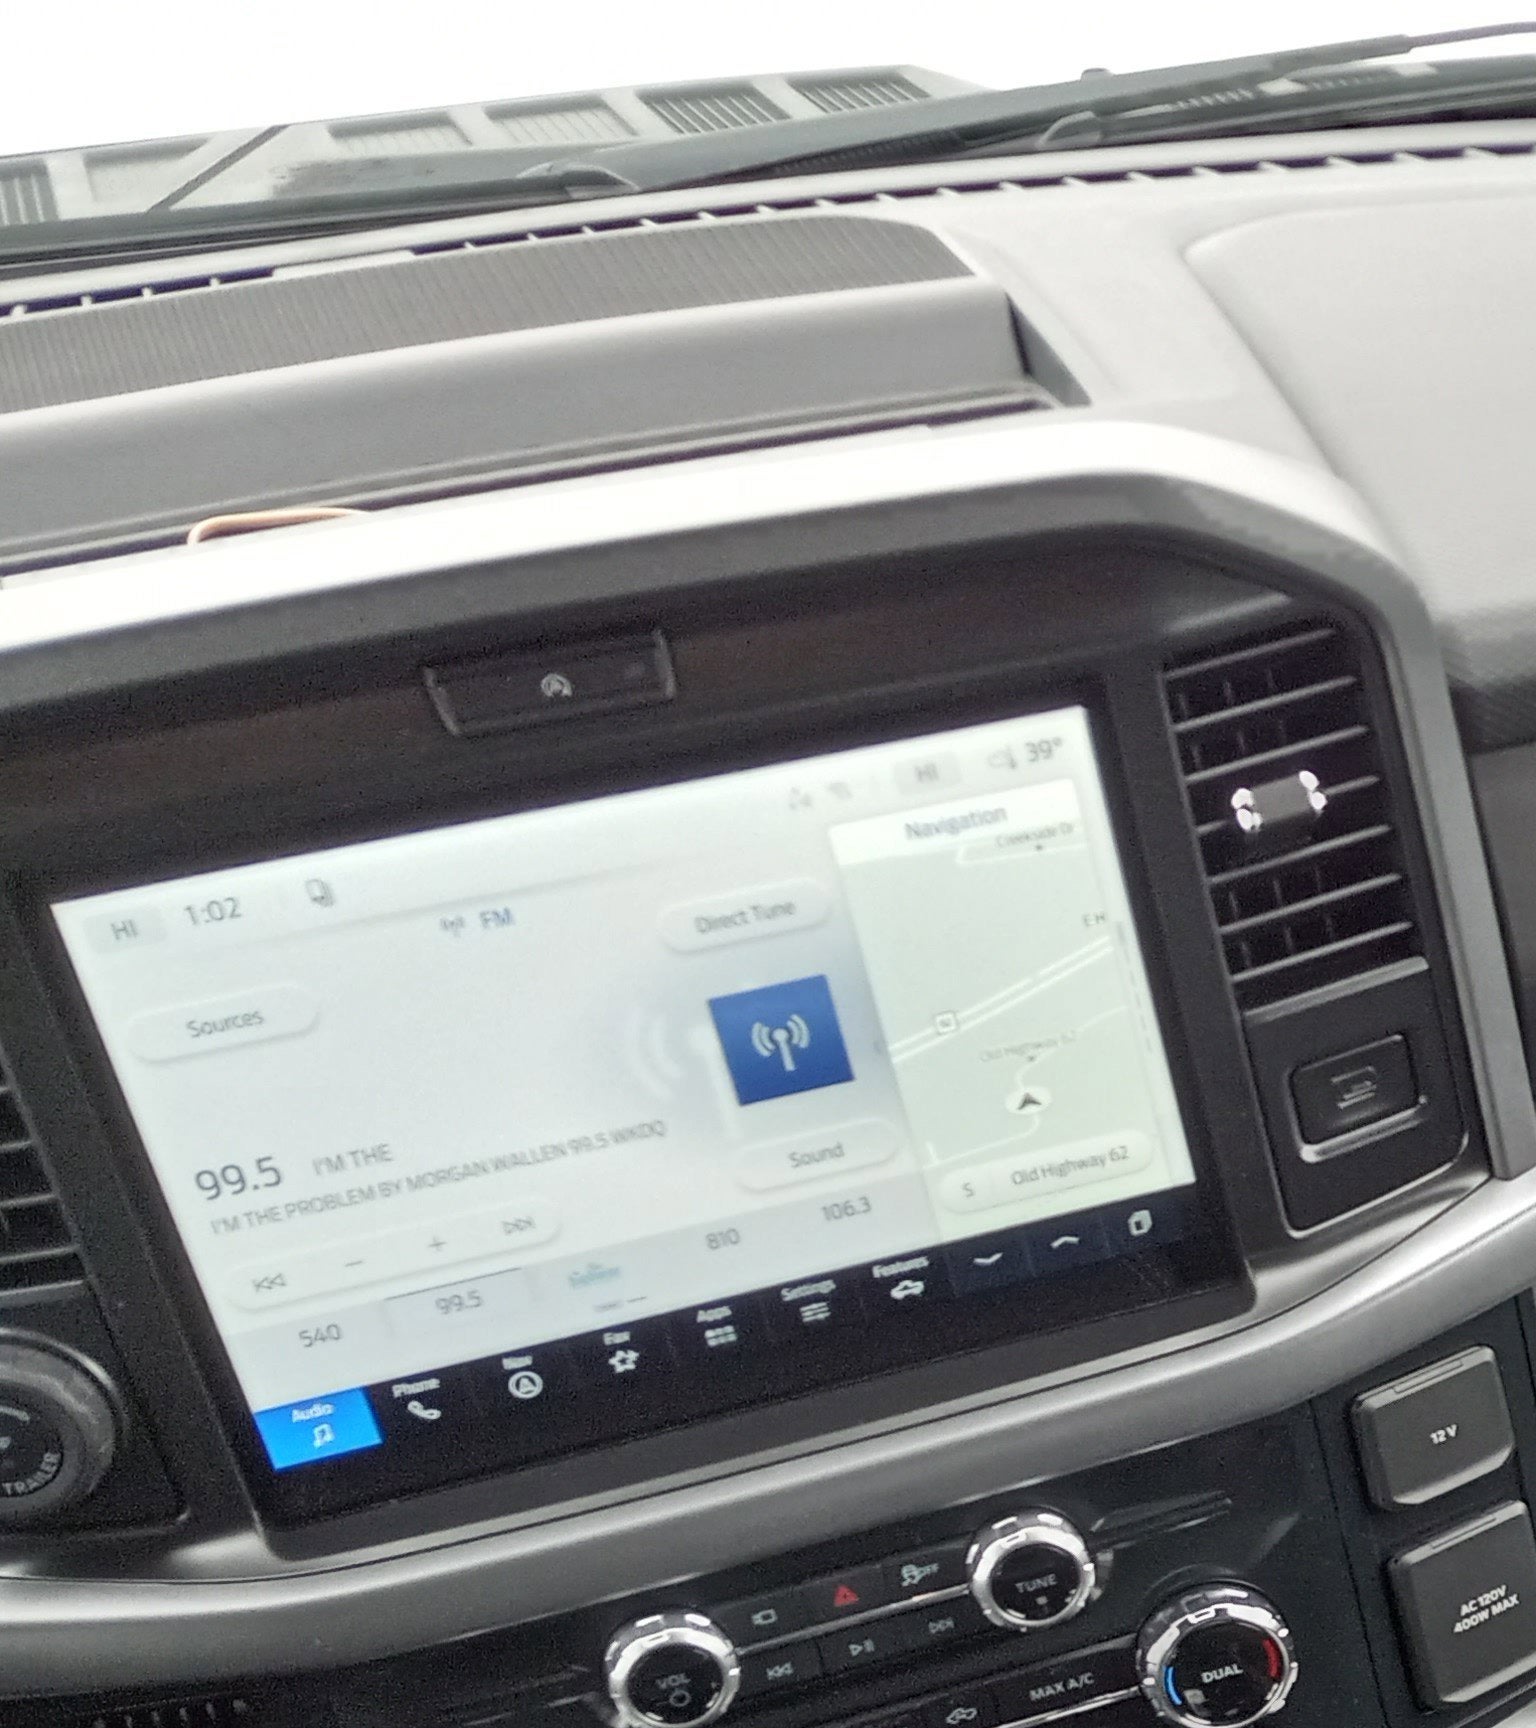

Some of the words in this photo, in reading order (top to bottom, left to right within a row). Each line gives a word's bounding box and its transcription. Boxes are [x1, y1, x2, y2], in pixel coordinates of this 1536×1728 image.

[904, 806, 1009, 842] Navigation
[183, 896, 243, 926] 1:02
[478, 906, 515, 932] FM
[694, 909, 749, 935] Direct
[749, 901, 797, 922] Tune
[110, 919, 138, 941] HI
[185, 1009, 265, 1039] Sources
[788, 1141, 846, 1169] Sound
[1009, 1167, 1041, 1187] Old
[1041, 1151, 1107, 1180] Highway
[1107, 1144, 1130, 1162] 62
[193, 1154, 283, 1202] 99.5
[349, 1142, 394, 1168] THE
[242, 1205, 284, 1228] THE
[283, 1184, 378, 1219] PROBLEM
[377, 1178, 402, 1198] BY
[404, 1159, 490, 1193] MORGAN
[490, 1142, 569, 1173] WALLEN
[566, 1131, 611, 1154] 99.5
[961, 1180, 977, 1199] S
[821, 1195, 873, 1222] 106.3
[705, 1227, 742, 1252] 810
[434, 1290, 483, 1316] 99.5
[298, 1322, 343, 1348] 540
[391, 1377, 441, 1399] Phone
[291, 1400, 336, 1423] Audio
[1, 1451, 62, 1496] TRAILER
[1014, 1573, 1059, 1594] TUNE
[1453, 1609, 1491, 1634] 400W
[1490, 1593, 1520, 1617] MAX
[1459, 1599, 1478, 1617] AC
[1478, 1584, 1508, 1608] 120V
[655, 1672, 692, 1690] VOL
[1029, 1680, 1066, 1702] MAX
[1066, 1671, 1095, 1691] A/C
[1200, 1662, 1244, 1684] DUAL
